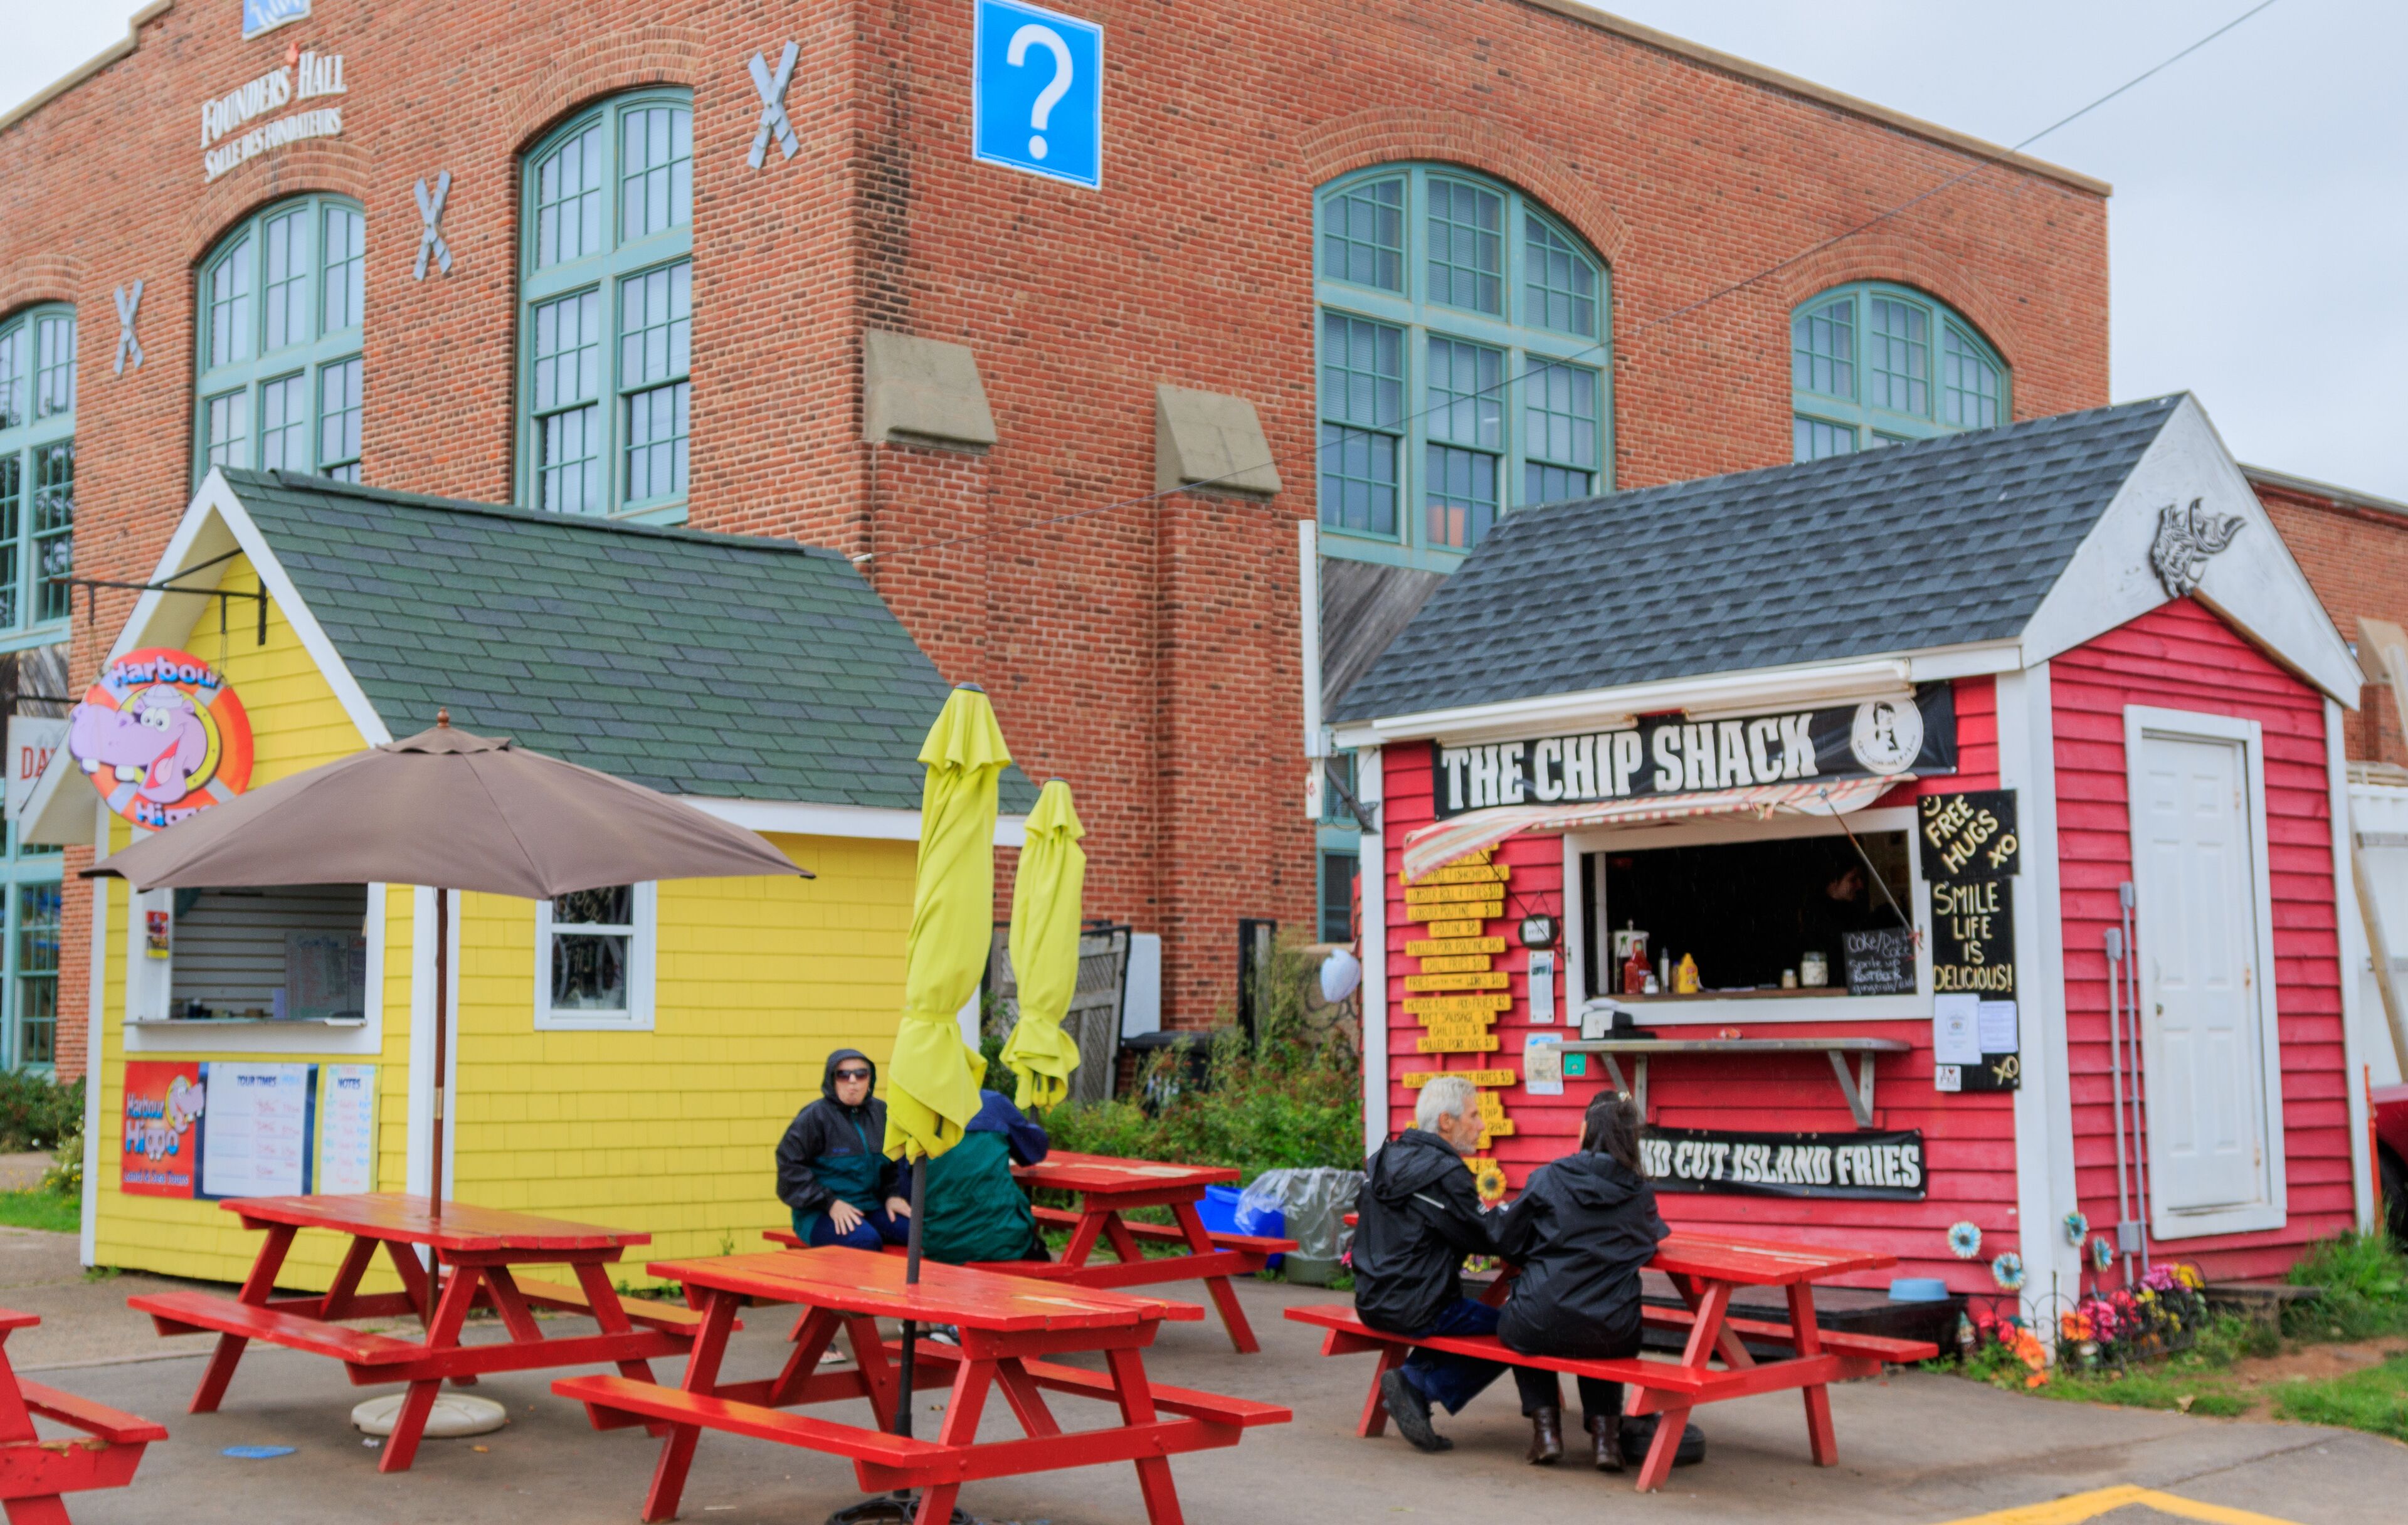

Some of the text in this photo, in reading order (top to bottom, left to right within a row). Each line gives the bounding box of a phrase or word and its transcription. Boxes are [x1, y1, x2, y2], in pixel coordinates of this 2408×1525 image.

[297, 51, 348, 100] HALL
[204, 107, 342, 183] SALLE DES FONDATEURS
[110, 655, 221, 689] Harbour
[21, 746, 56, 780] DA
[1442, 712, 1819, 810] THE CHIP SHACK
[1925, 794, 1975, 849] FREE
[1942, 808, 1999, 875] HUGS
[1987, 834, 2018, 870] XO
[1933, 881, 2001, 916] SMILE
[1953, 916, 1993, 941] LIFE
[1963, 939, 1985, 965] IS
[1933, 964, 2012, 993] DELICIOUS!
[256, 1075, 277, 1087] TIMES
[337, 1078, 361, 1090] NOTES
[1476, 1072, 1498, 1084] FRIES
[1992, 1055, 2019, 1086] XO
[126, 1092, 164, 1119] Harbour
[1485, 1108, 1498, 1118] DIP
[125, 1119, 179, 1160] Hippo
[124, 1168, 142, 1183] Land
[152, 1170, 166, 1185] Sea
[167, 1171, 189, 1186] Tours
[1638, 1138, 1921, 1188] ND CUT ISLAND FRIES
